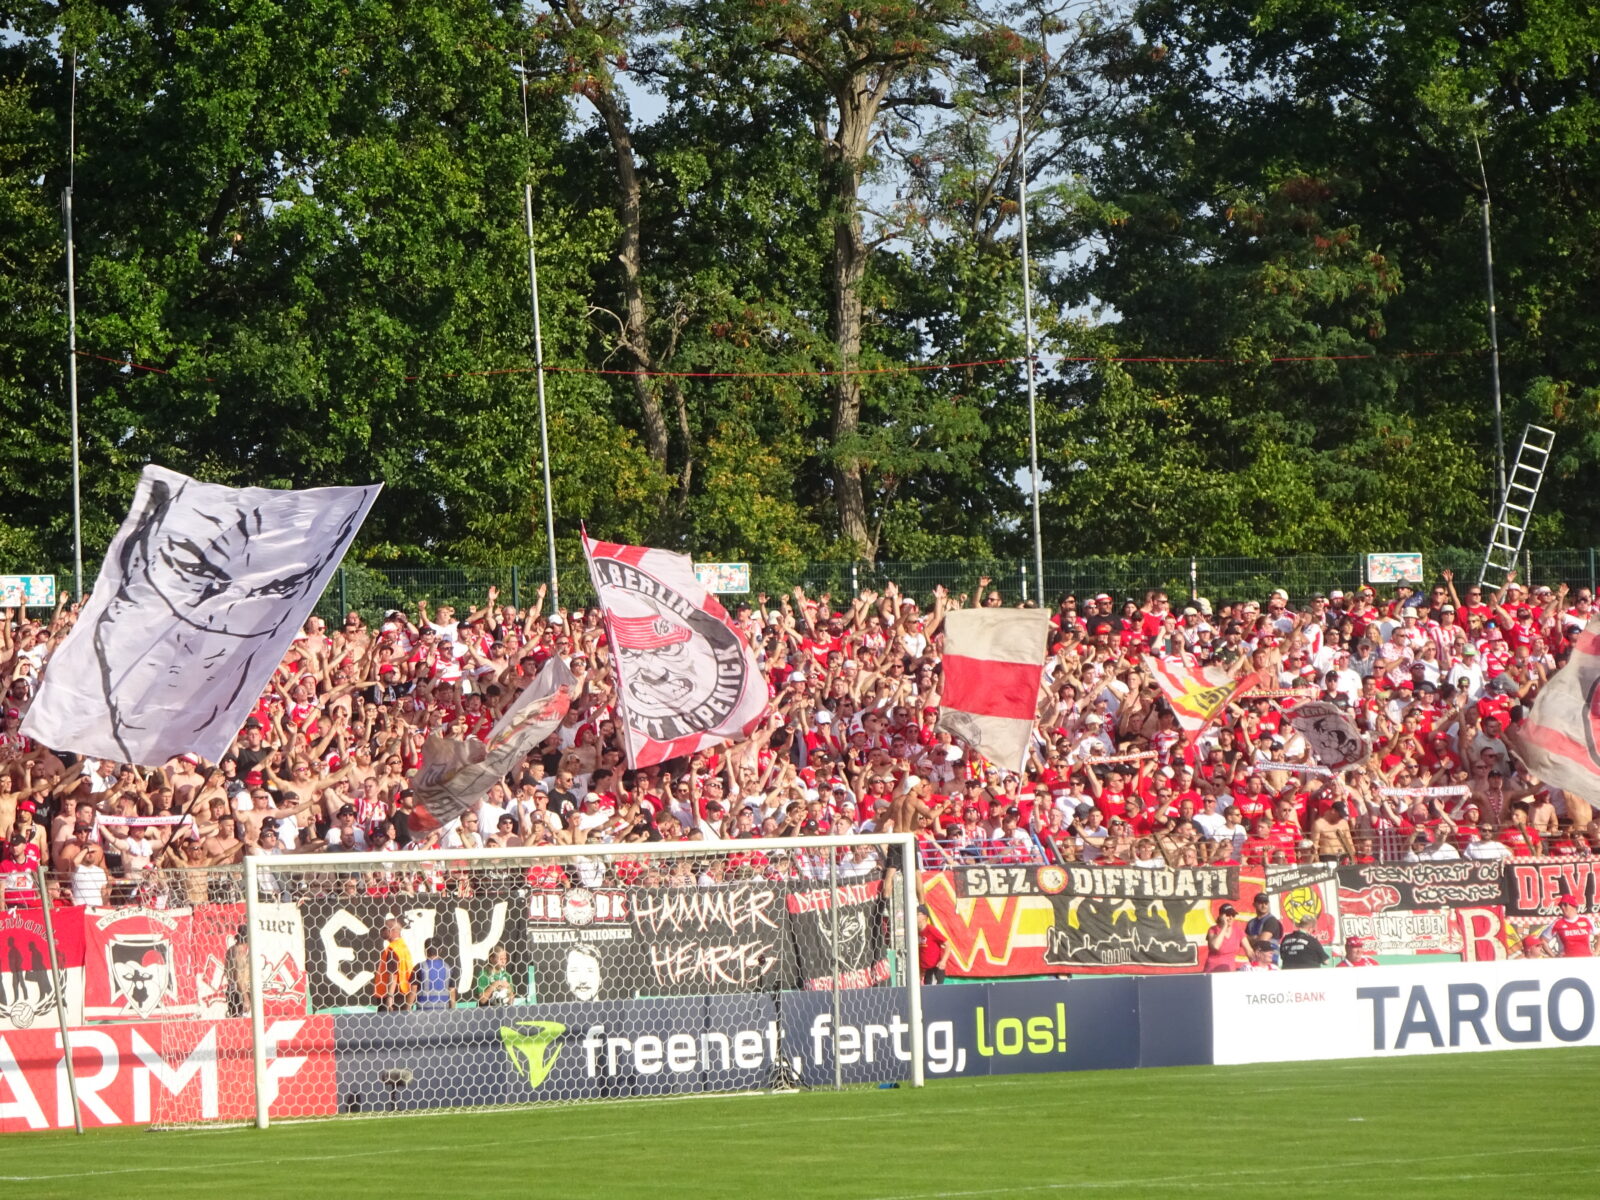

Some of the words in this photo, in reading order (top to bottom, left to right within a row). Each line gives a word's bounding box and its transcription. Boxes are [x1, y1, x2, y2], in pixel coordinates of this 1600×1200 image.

[608, 562, 695, 619] BERLIN
[1072, 866, 1230, 897] DIFFIDATI
[632, 885, 779, 937] HAMMER
[1343, 917, 1371, 938] EINS
[651, 940, 777, 988] HEARTS
[810, 1014, 967, 1073] fertg,
[976, 1002, 1067, 1057] los!
[1356, 976, 1596, 1051] TARGO
